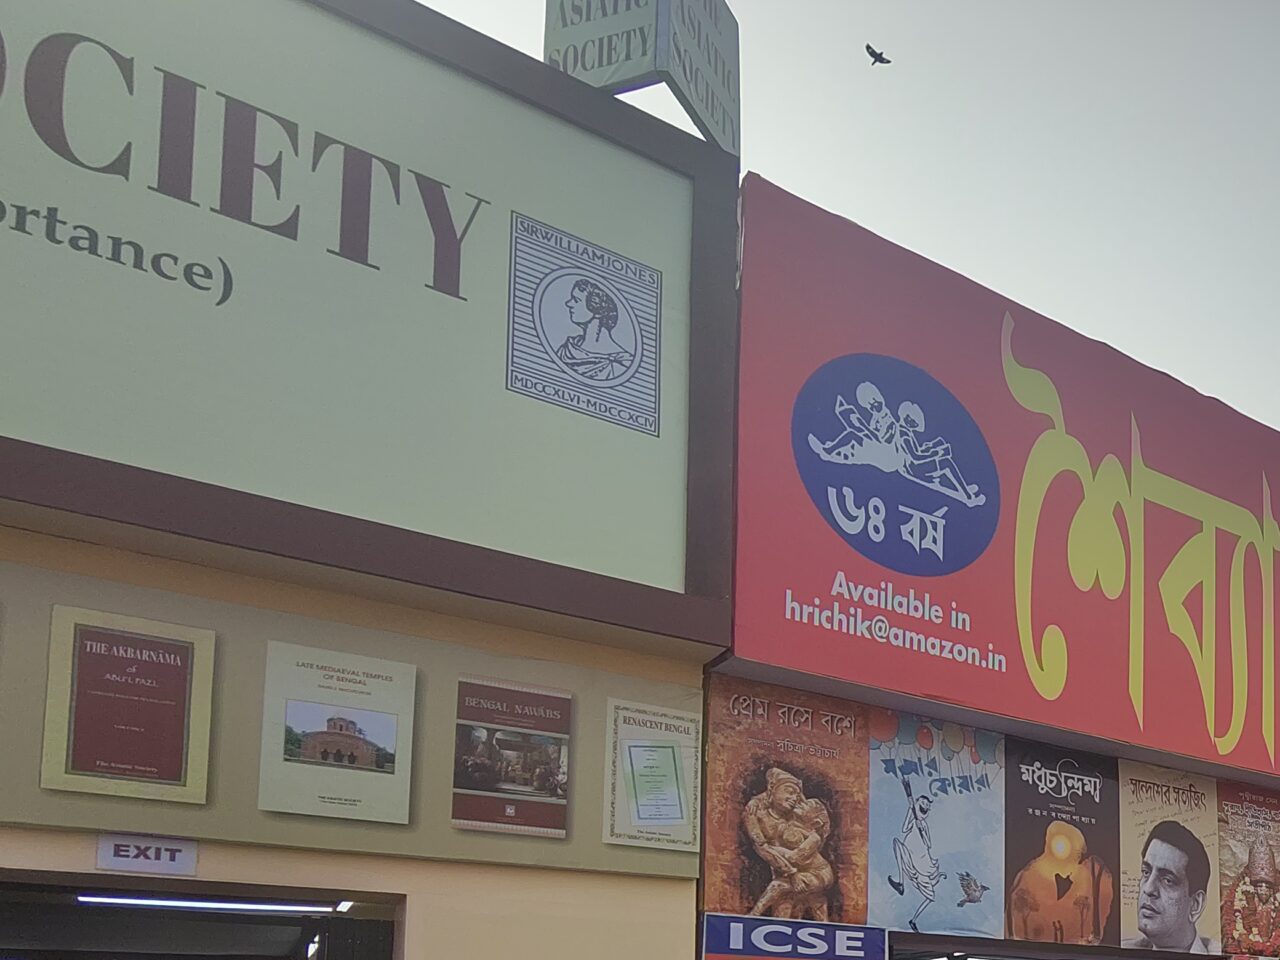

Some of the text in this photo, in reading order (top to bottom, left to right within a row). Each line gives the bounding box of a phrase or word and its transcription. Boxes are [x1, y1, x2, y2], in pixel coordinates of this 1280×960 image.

[550, 24, 652, 74] SOCIETY
[0, 32, 491, 301] CIETY
[0, 203, 233, 306] rtance)
[827, 486, 949, 562] ৬৪ বর্ষ
[830, 570, 970, 631] Available in
[84, 640, 109, 655] THE
[785, 589, 1006, 672] hrichik@amazon.in
[296, 661, 314, 670] LATE
[362, 671, 393, 682] TEMPLES
[336, 677, 367, 686] BENGAL
[465, 697, 510, 712] BENGAL
[730, 694, 856, 738] প্রেম রসে বশে
[623, 715, 691, 736] RENASCENT BENGAL
[113, 843, 182, 862] EXIT
[729, 922, 865, 957] ICSE
